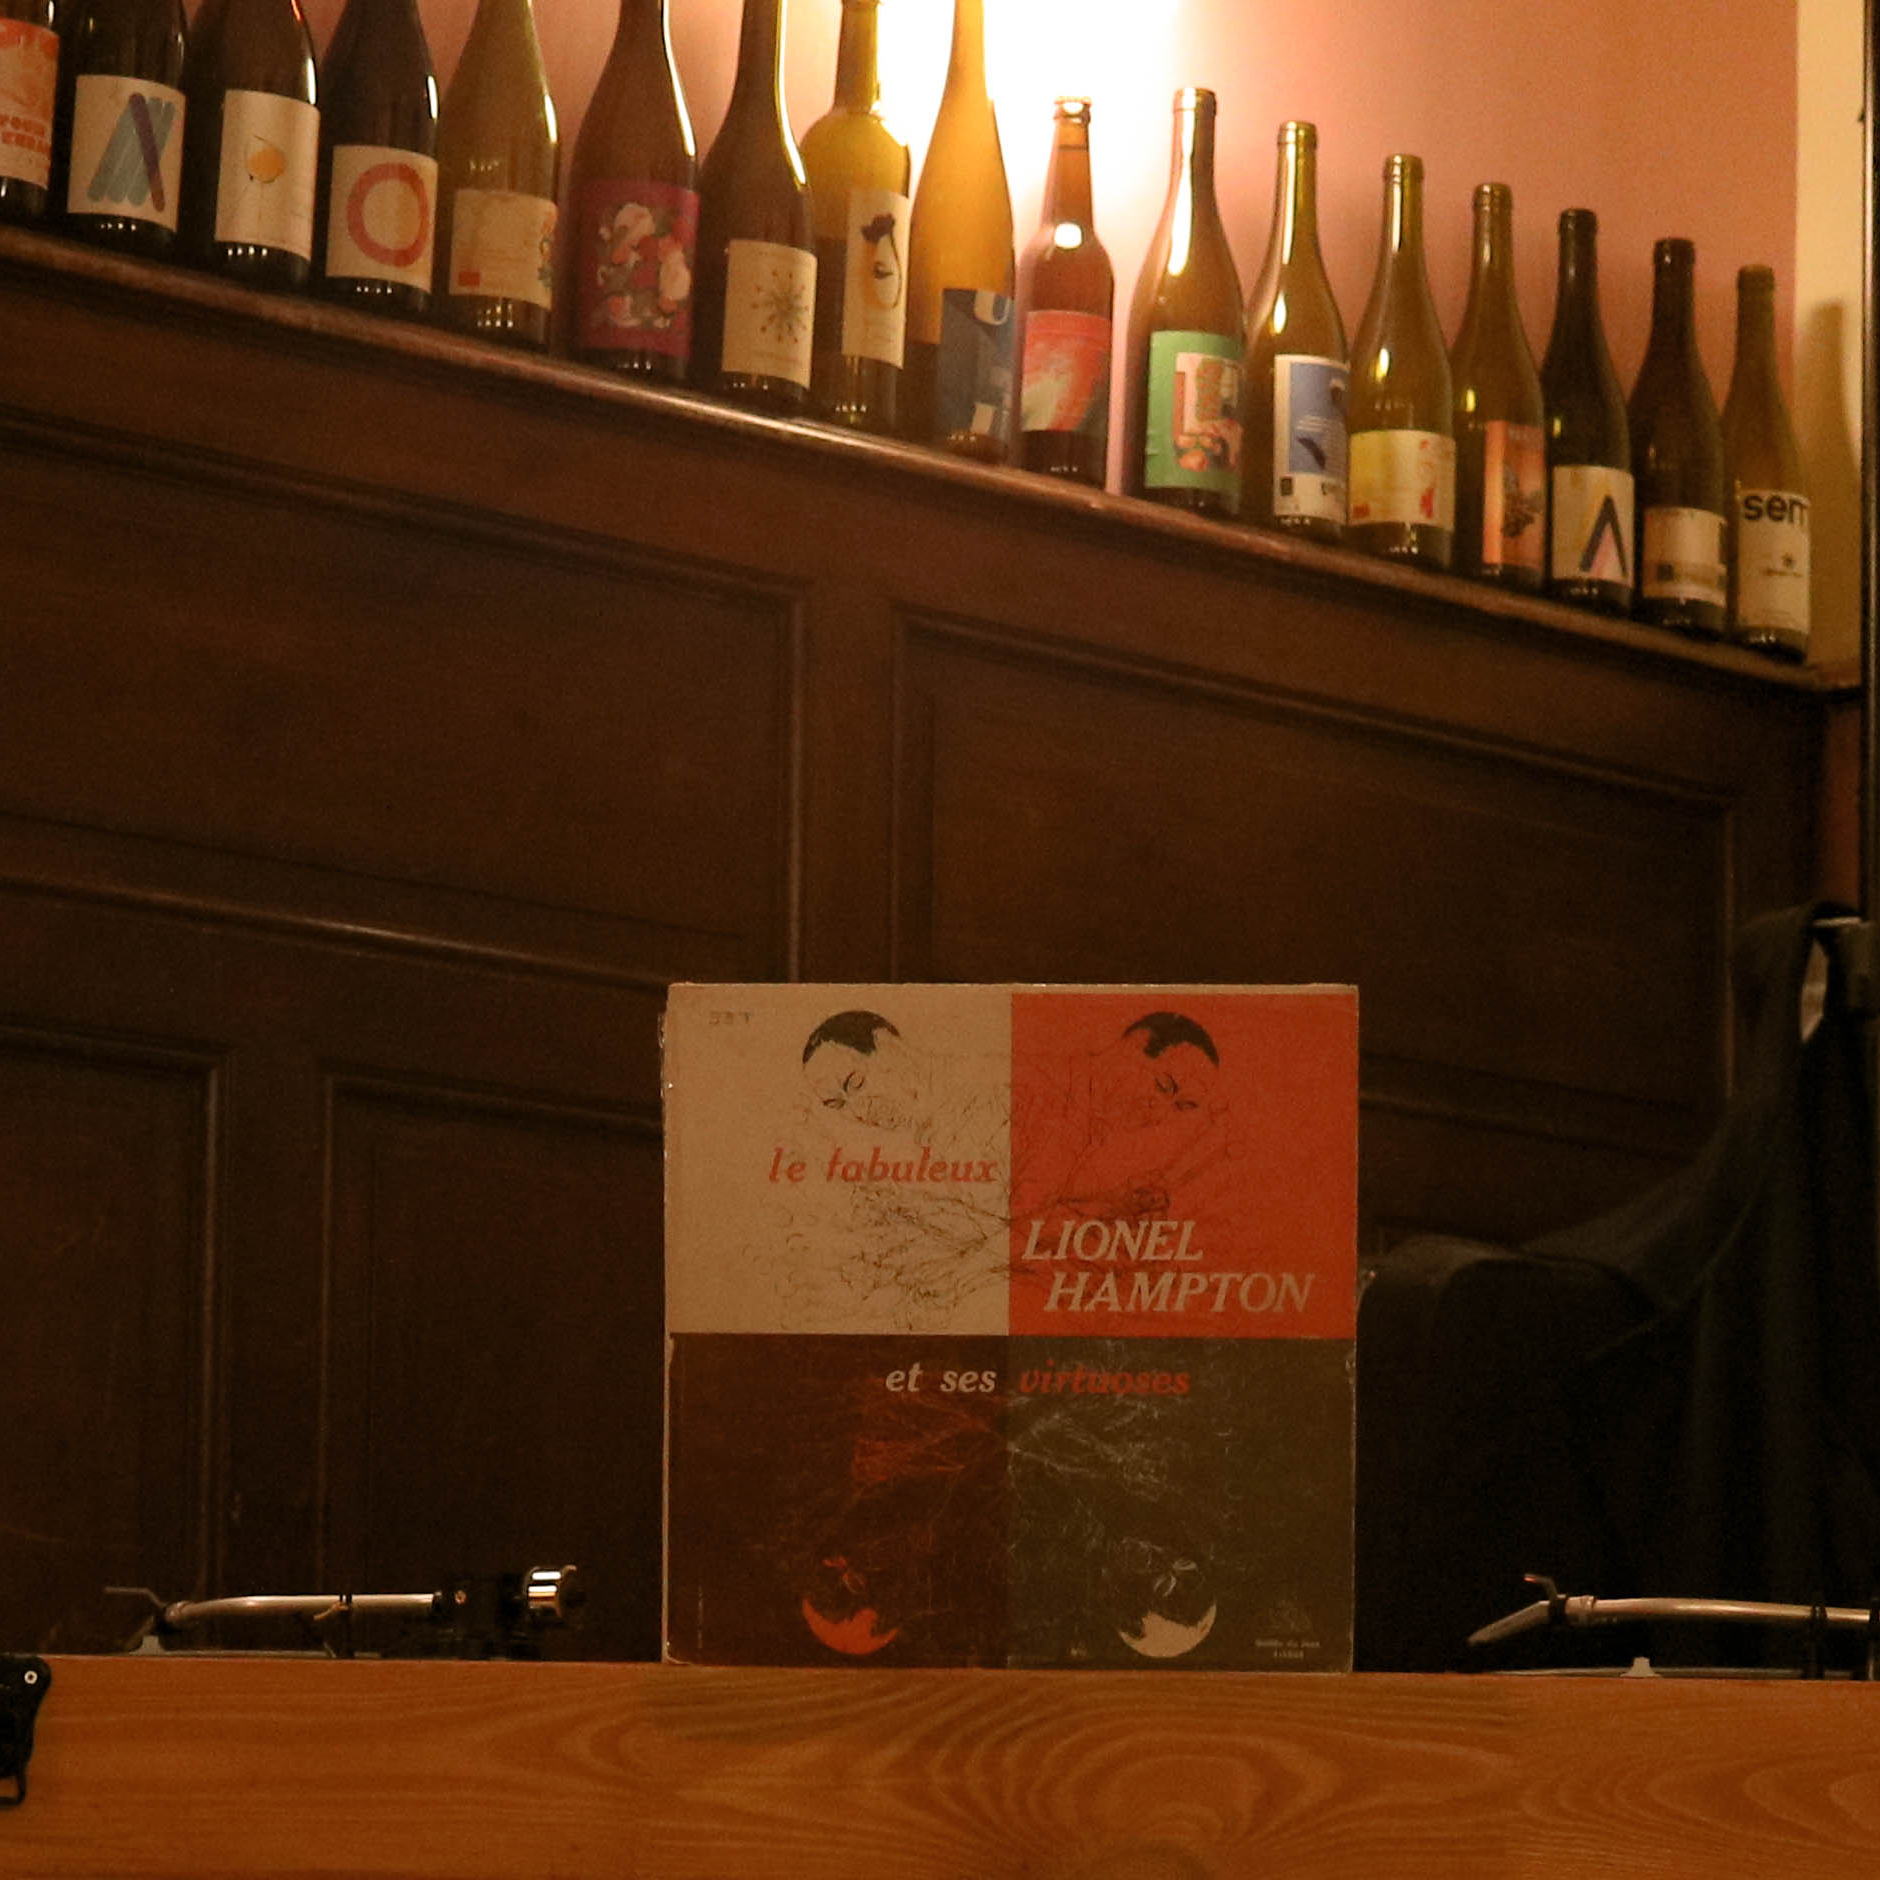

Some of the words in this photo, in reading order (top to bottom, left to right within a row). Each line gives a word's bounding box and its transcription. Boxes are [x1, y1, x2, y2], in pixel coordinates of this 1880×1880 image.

[767, 1146, 808, 1185] le
[1020, 1219, 1205, 1263] LIONEL
[1043, 1271, 1316, 1314] HAMPTON
[884, 1361, 922, 1394] et
[939, 1370, 997, 1395] ses
